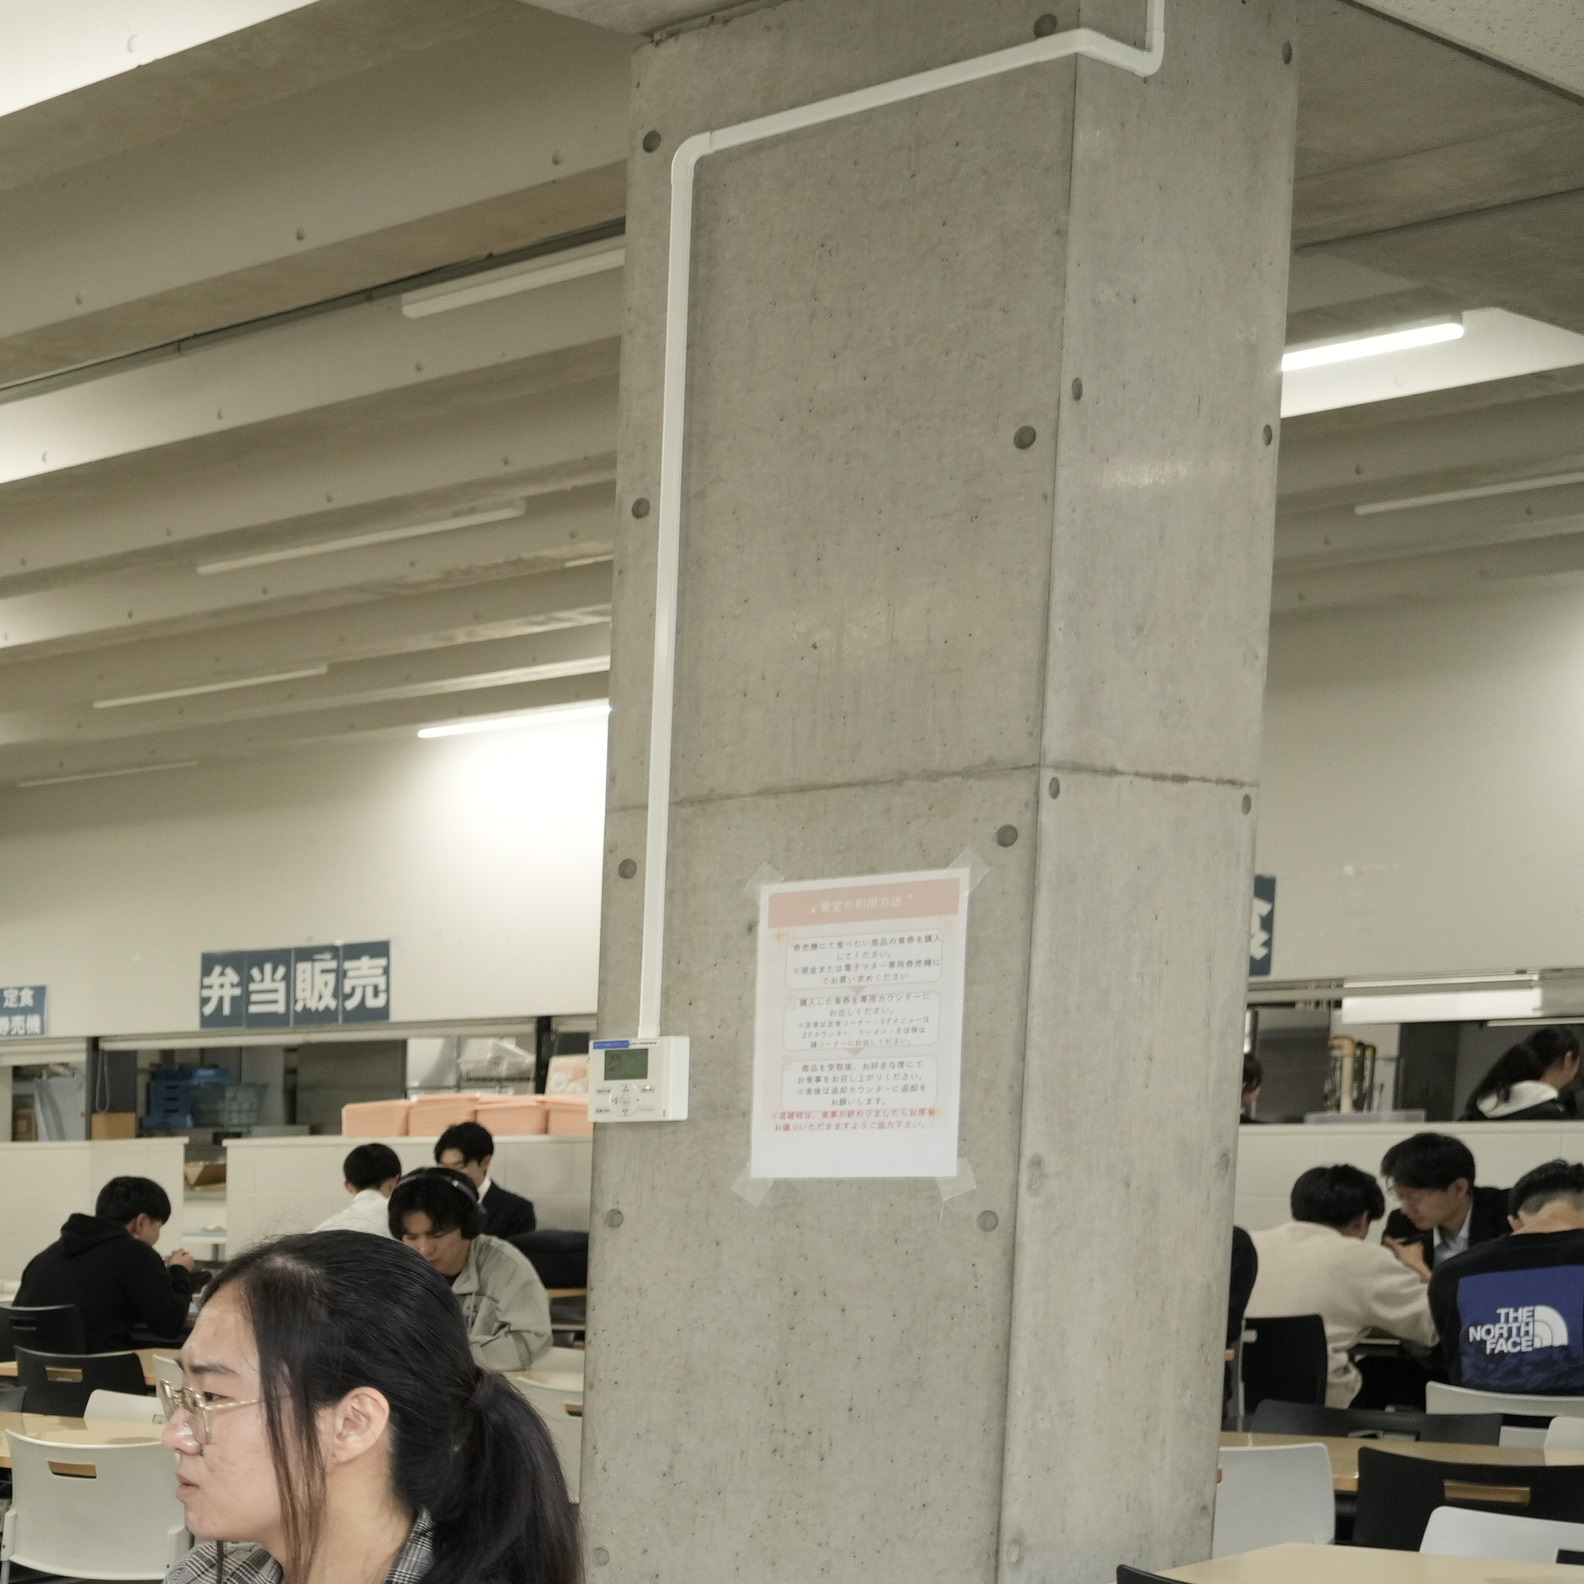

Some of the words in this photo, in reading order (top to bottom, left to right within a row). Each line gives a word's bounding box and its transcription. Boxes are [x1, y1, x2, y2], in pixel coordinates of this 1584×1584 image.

[820, 895, 903, 913] 食堂の利用方法
[793, 934, 941, 951] 券売機にて食べたい商品の食券を購入
[200, 955, 389, 1017] 弁当販売
[3, 988, 34, 1008] 定食
[1496, 1305, 1534, 1324] THE
[1468, 1320, 1534, 1342] NORTH
[1486, 1336, 1534, 1354] FACE
